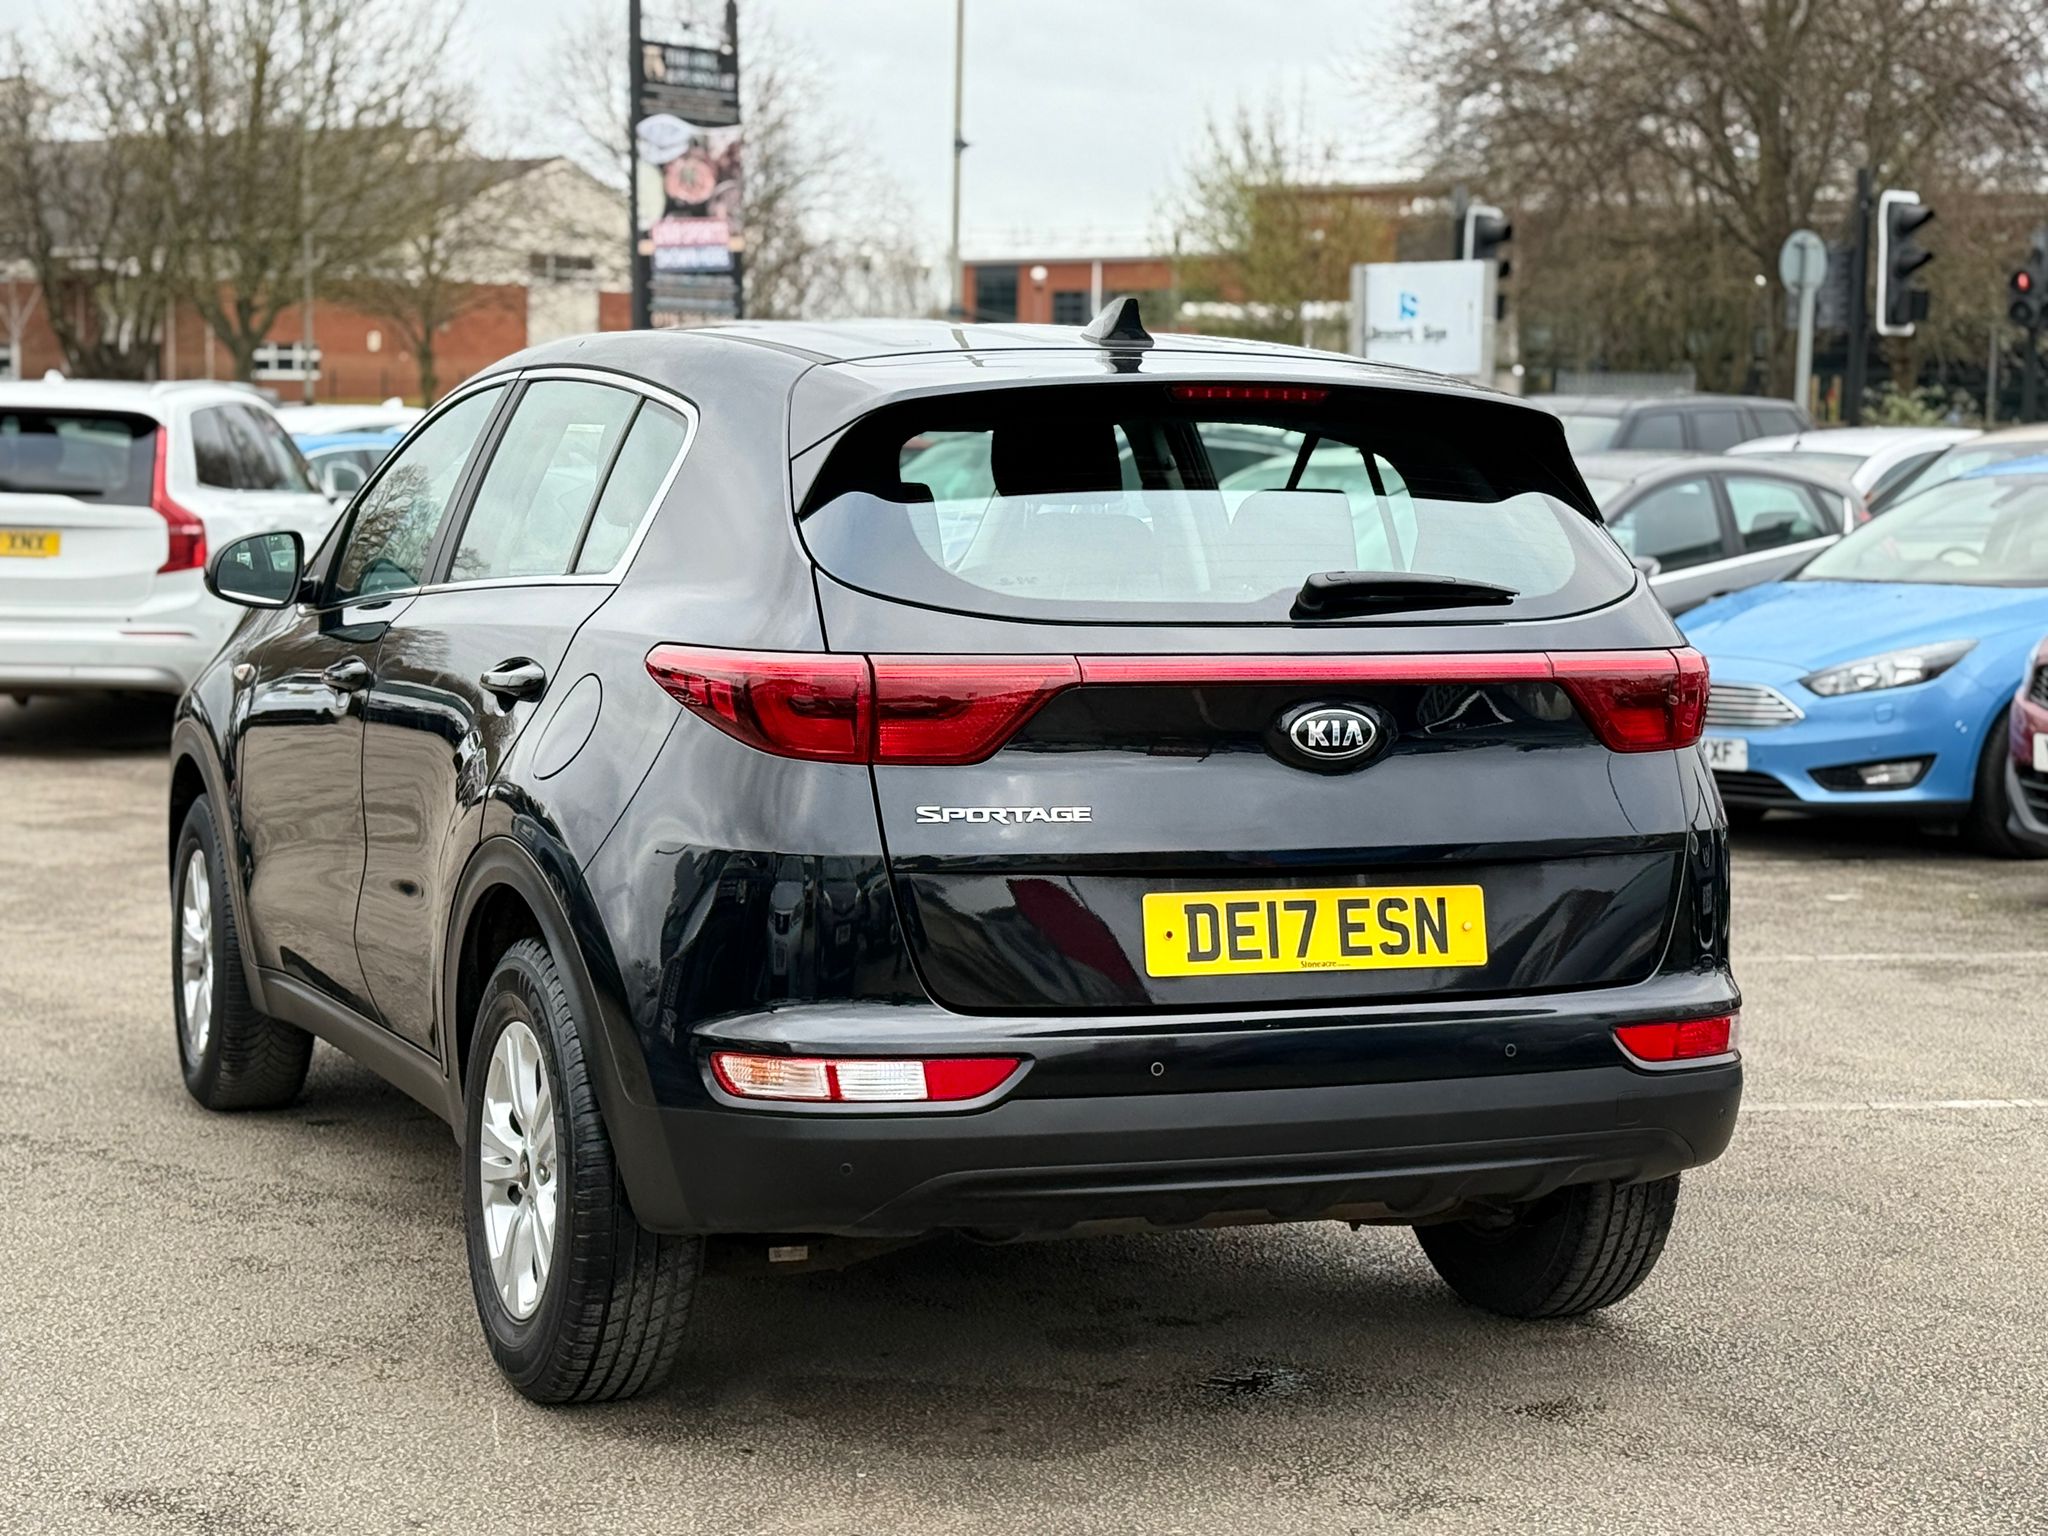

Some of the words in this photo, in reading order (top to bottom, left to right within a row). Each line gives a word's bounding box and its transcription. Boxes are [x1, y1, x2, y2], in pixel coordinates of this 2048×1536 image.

[1306, 720, 1364, 747] KIA
[915, 805, 1093, 825] SPORTAGE
[1184, 899, 1317, 963] DE17
[1337, 897, 1449, 957] ESN
